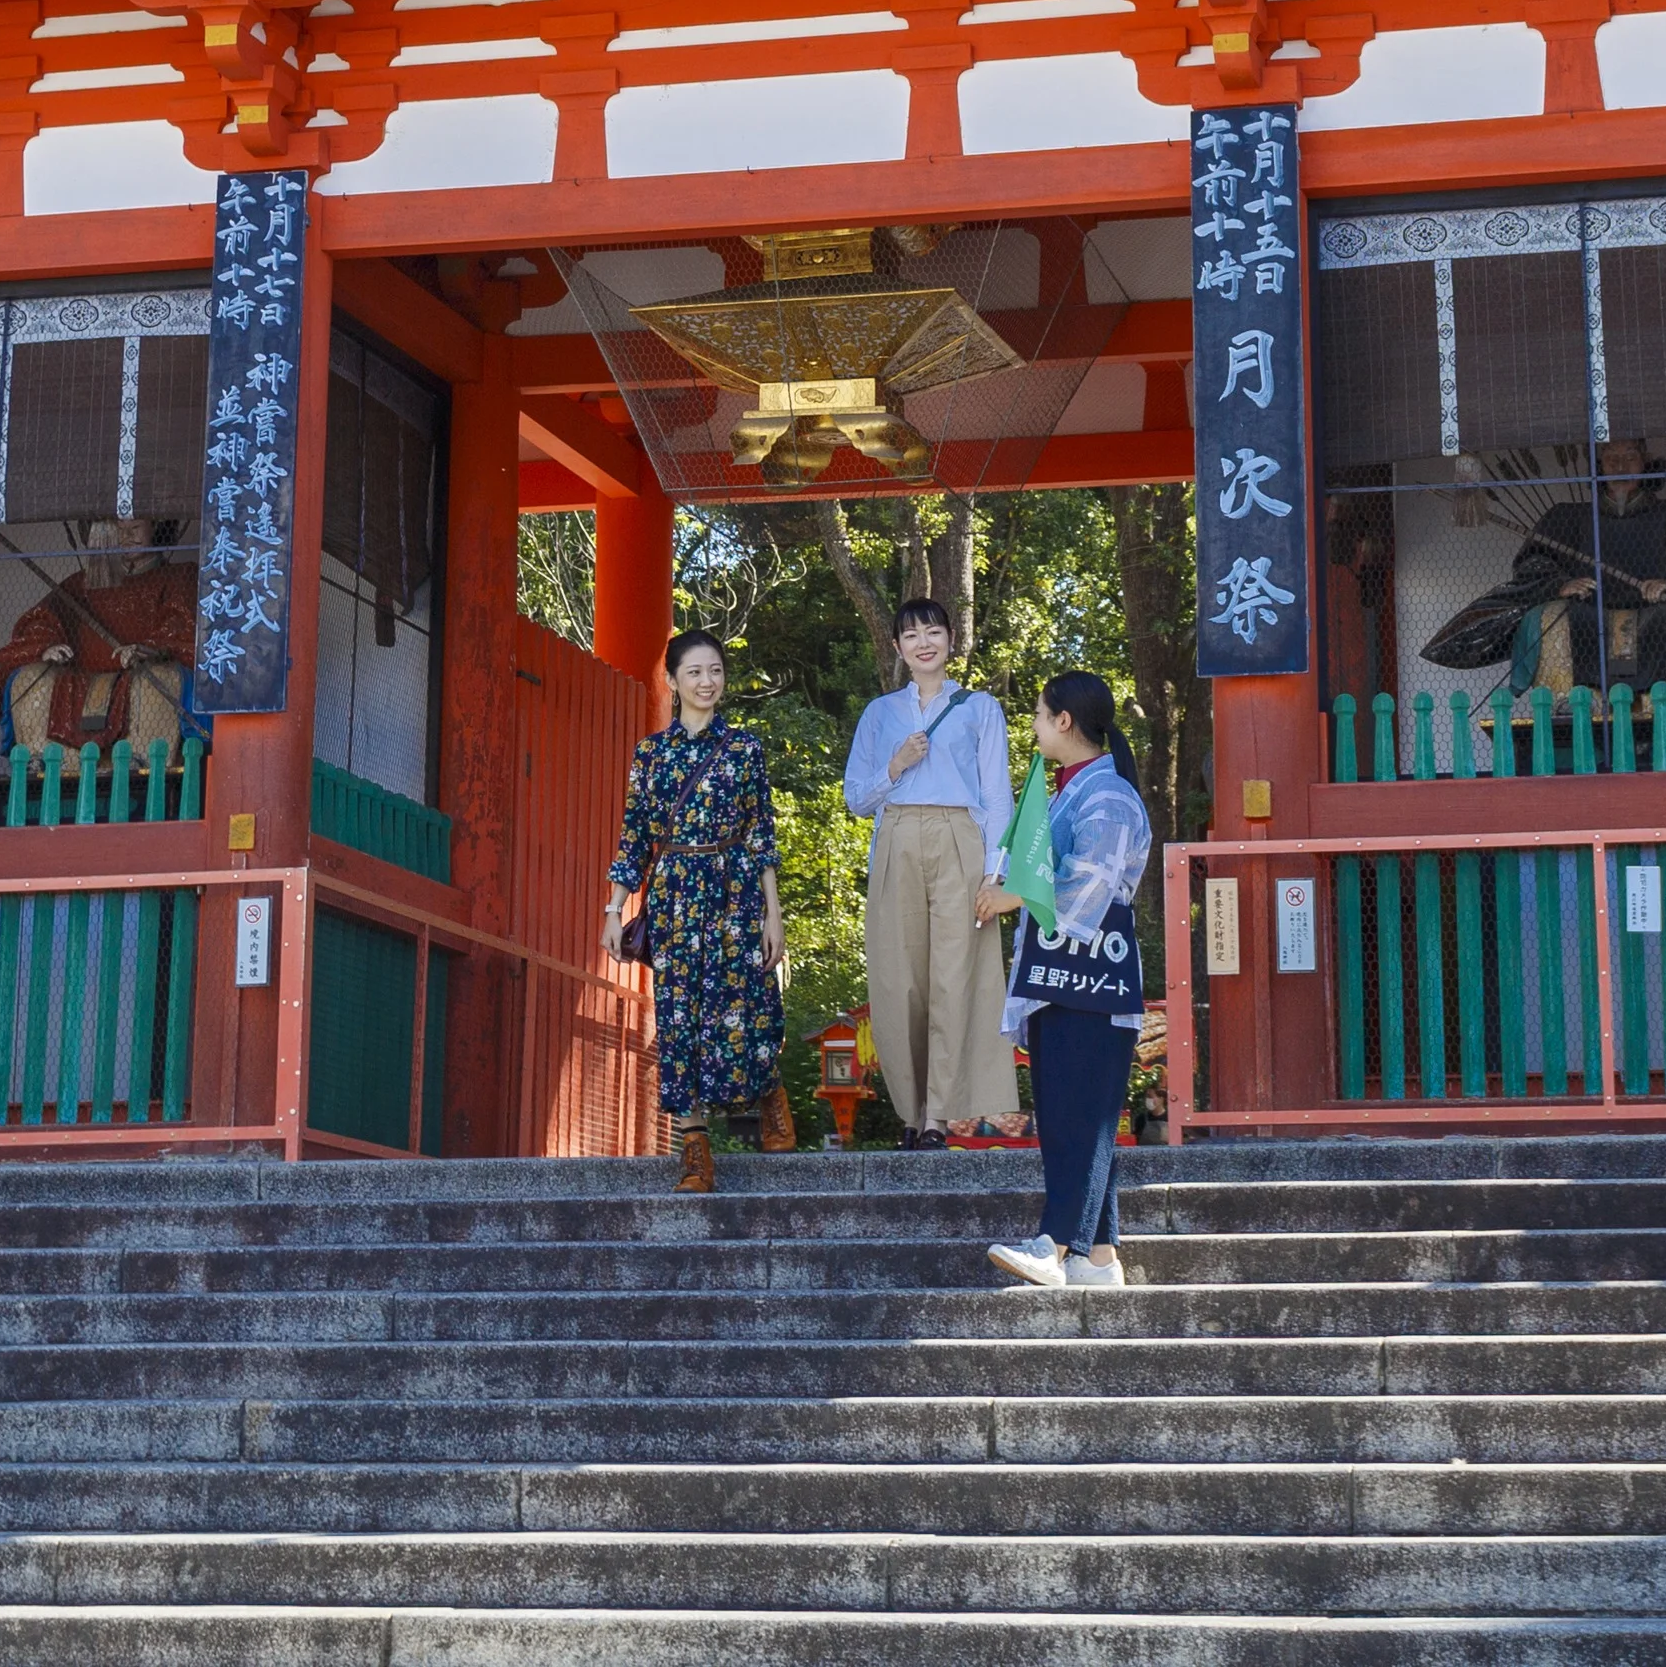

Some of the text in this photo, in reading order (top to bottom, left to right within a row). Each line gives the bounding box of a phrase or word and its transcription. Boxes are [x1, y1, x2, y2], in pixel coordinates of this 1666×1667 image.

[216, 178, 259, 330] 午前十時
[256, 175, 303, 325] 十月十七日
[1192, 114, 1247, 301] 午前十時
[1241, 110, 1295, 294] 十月十五日
[1208, 330, 1296, 645] 月次祭
[1026, 965, 1130, 996] 星野リゾート
[1214, 888, 1226, 962] 重要文化財指定
